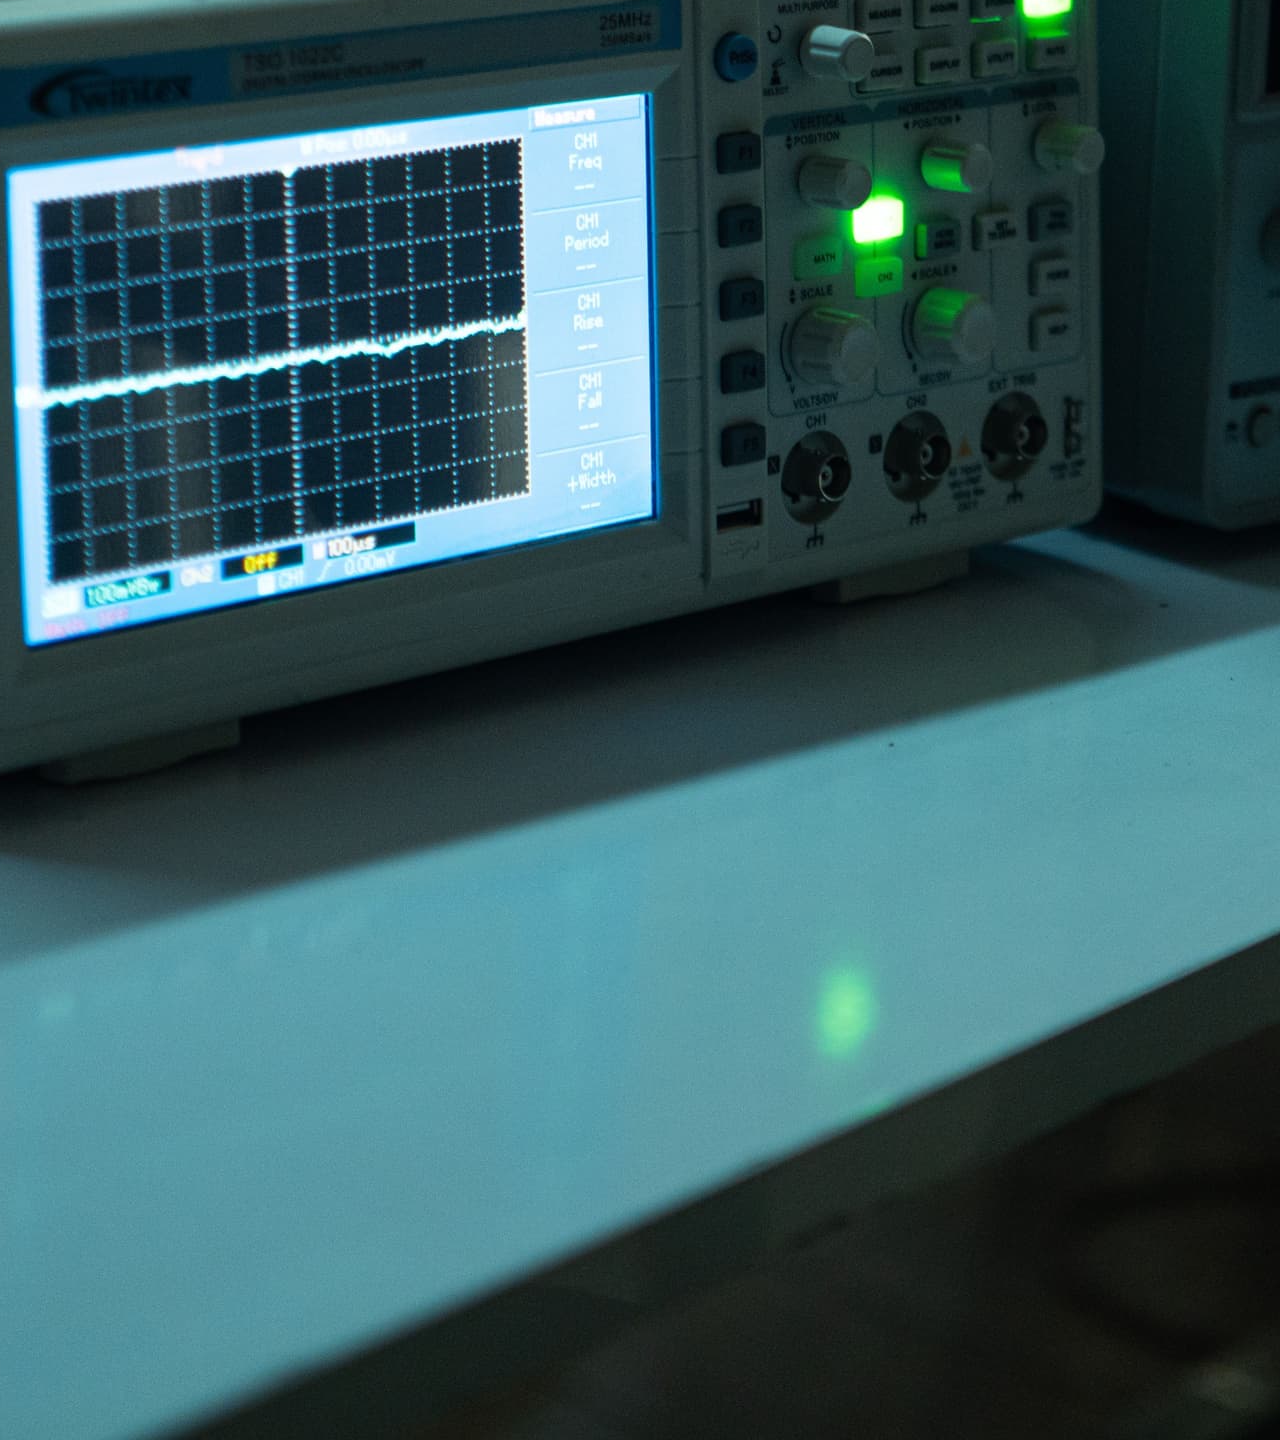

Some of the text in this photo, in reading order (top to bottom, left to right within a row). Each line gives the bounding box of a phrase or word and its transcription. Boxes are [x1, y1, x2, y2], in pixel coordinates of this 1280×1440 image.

[778, 1, 800, 15] MULTI
[869, 7, 902, 20] MEASURE
[600, 11, 652, 31] 25MHz
[870, 65, 903, 78] CURSOR
[533, 108, 596, 127] Measure
[791, 112, 847, 130] VERTICAL
[912, 115, 953, 129] POSITION
[574, 132, 598, 150] CH1
[794, 130, 840, 146] POSITION
[568, 154, 603, 172] Freq
[575, 212, 599, 231] CH1
[564, 230, 609, 252] Period
[814, 252, 836, 265] MATH
[801, 285, 833, 299] SCALE
[577, 292, 600, 311] CH1
[573, 314, 604, 331] Rise
[579, 371, 602, 390] CH1
[577, 392, 603, 410] Fall
[906, 394, 927, 409] CH2
[805, 414, 827, 430] CH1
[580, 451, 604, 470] CH1
[567, 470, 617, 492] +Width
